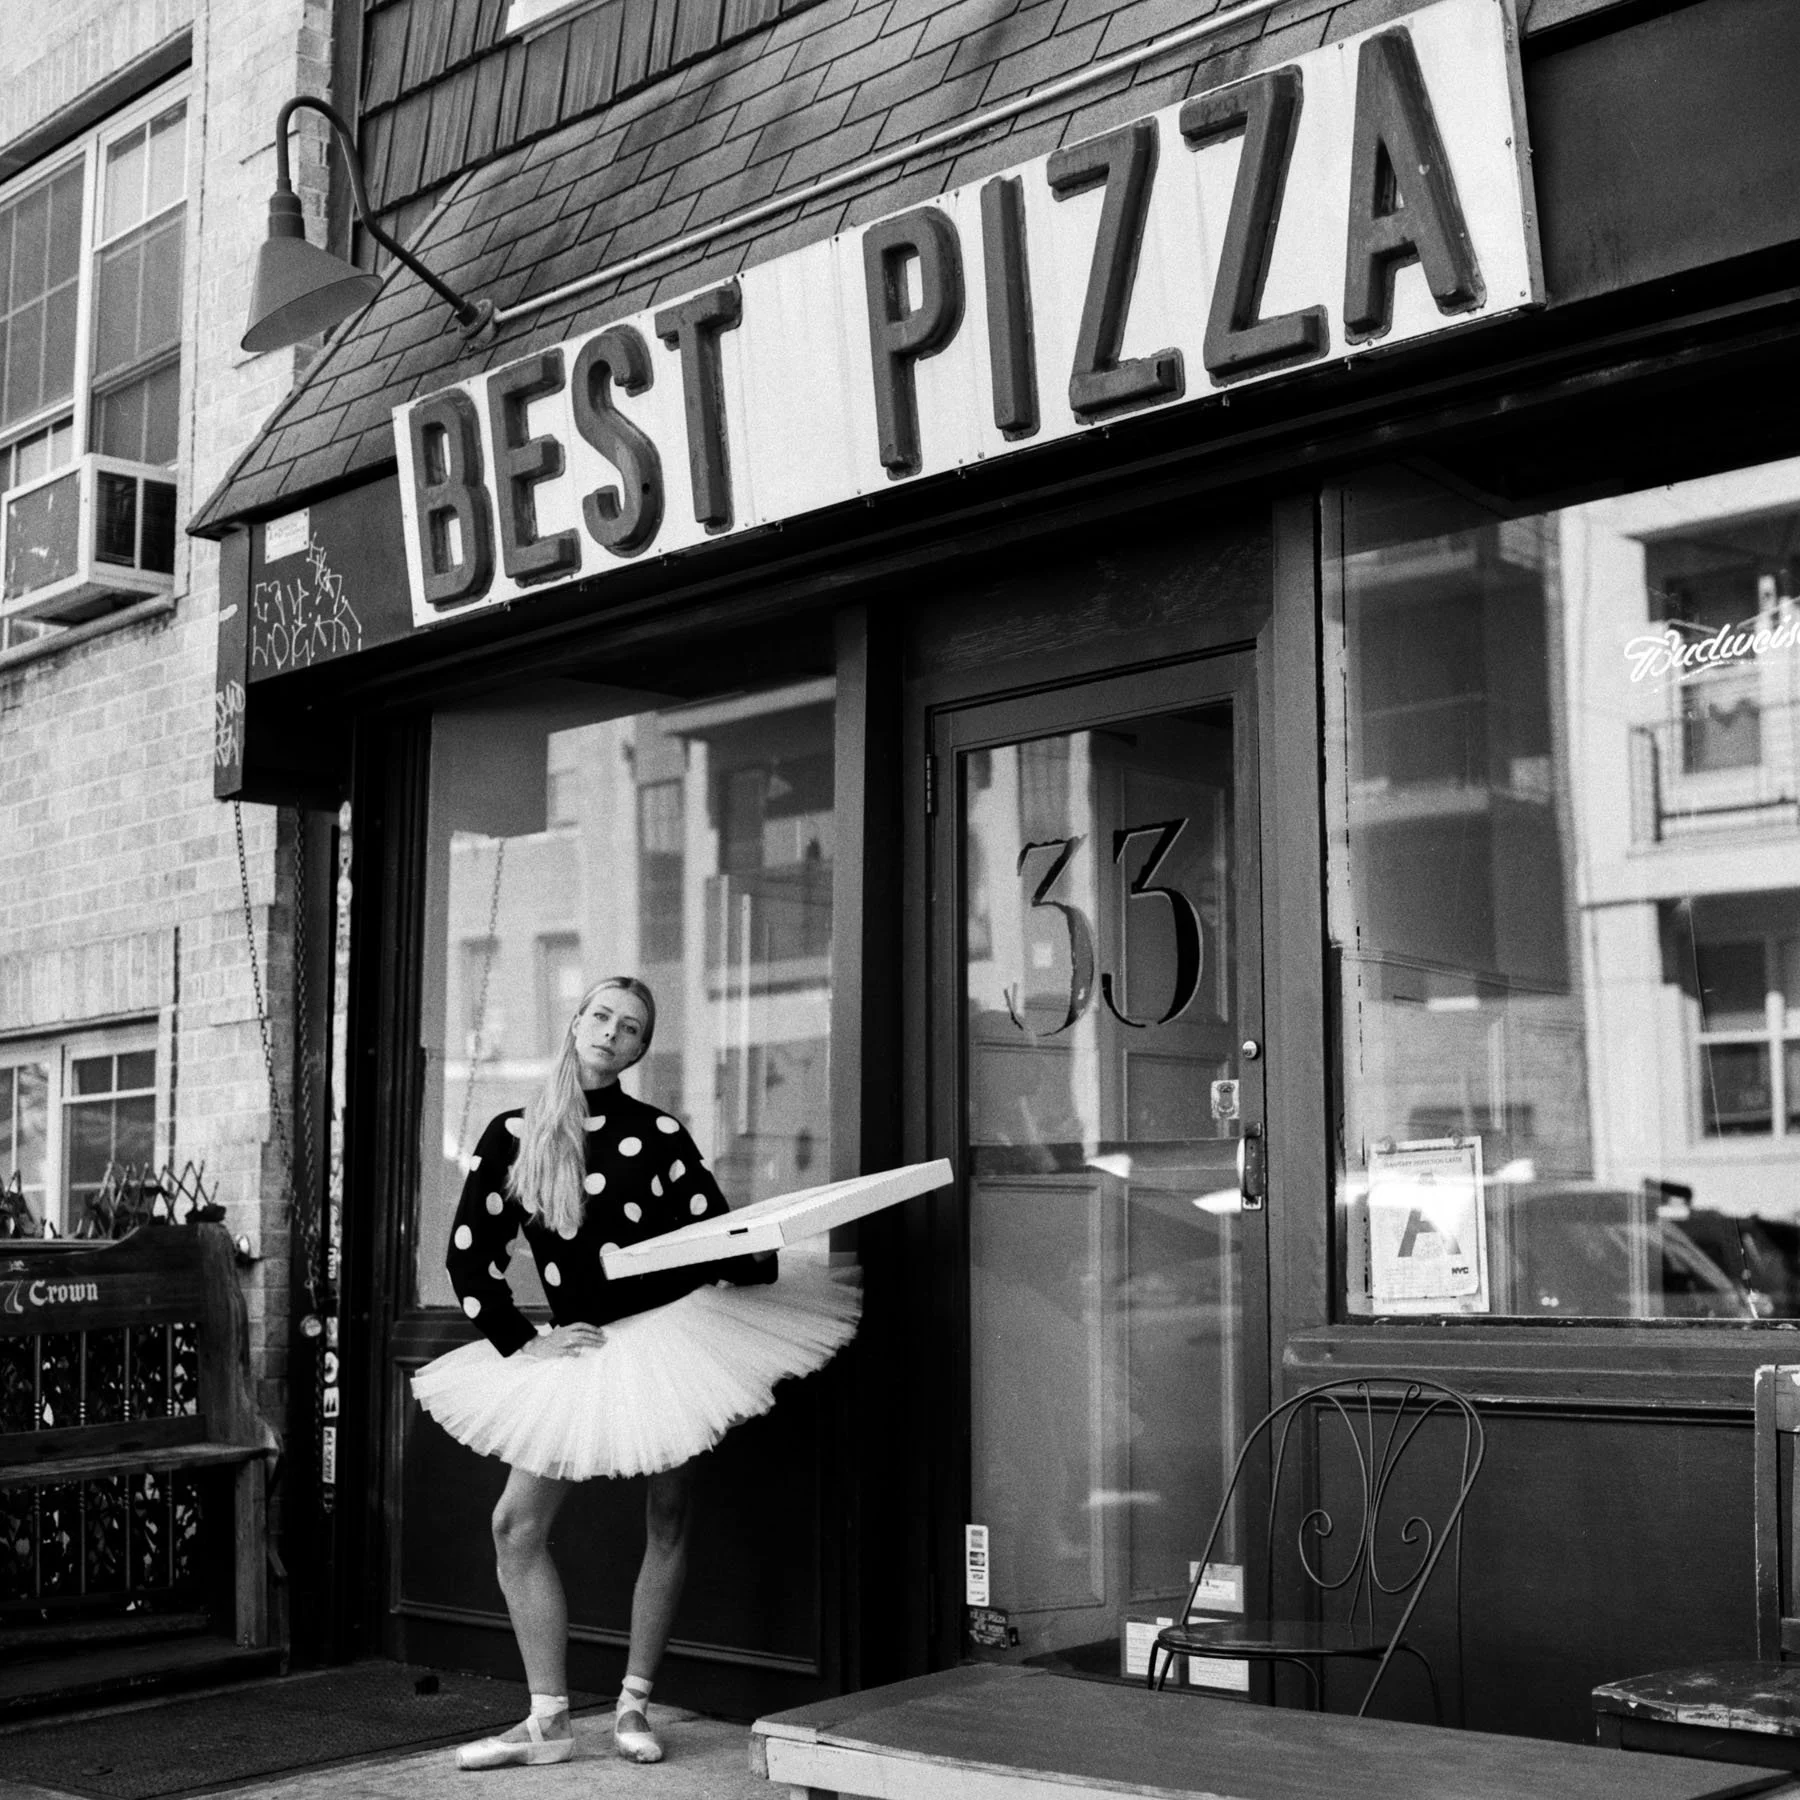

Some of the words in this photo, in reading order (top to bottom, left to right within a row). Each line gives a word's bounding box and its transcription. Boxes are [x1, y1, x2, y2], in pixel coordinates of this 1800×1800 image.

[408, 278, 743, 613] BEST
[862, 23, 1487, 481] PIZZA
[1623, 614, 1800, 682] Budweis
[1003, 817, 1205, 1038] 33
[29, 1279, 98, 1307] Crown
[1451, 1266, 1469, 1275] NYC
